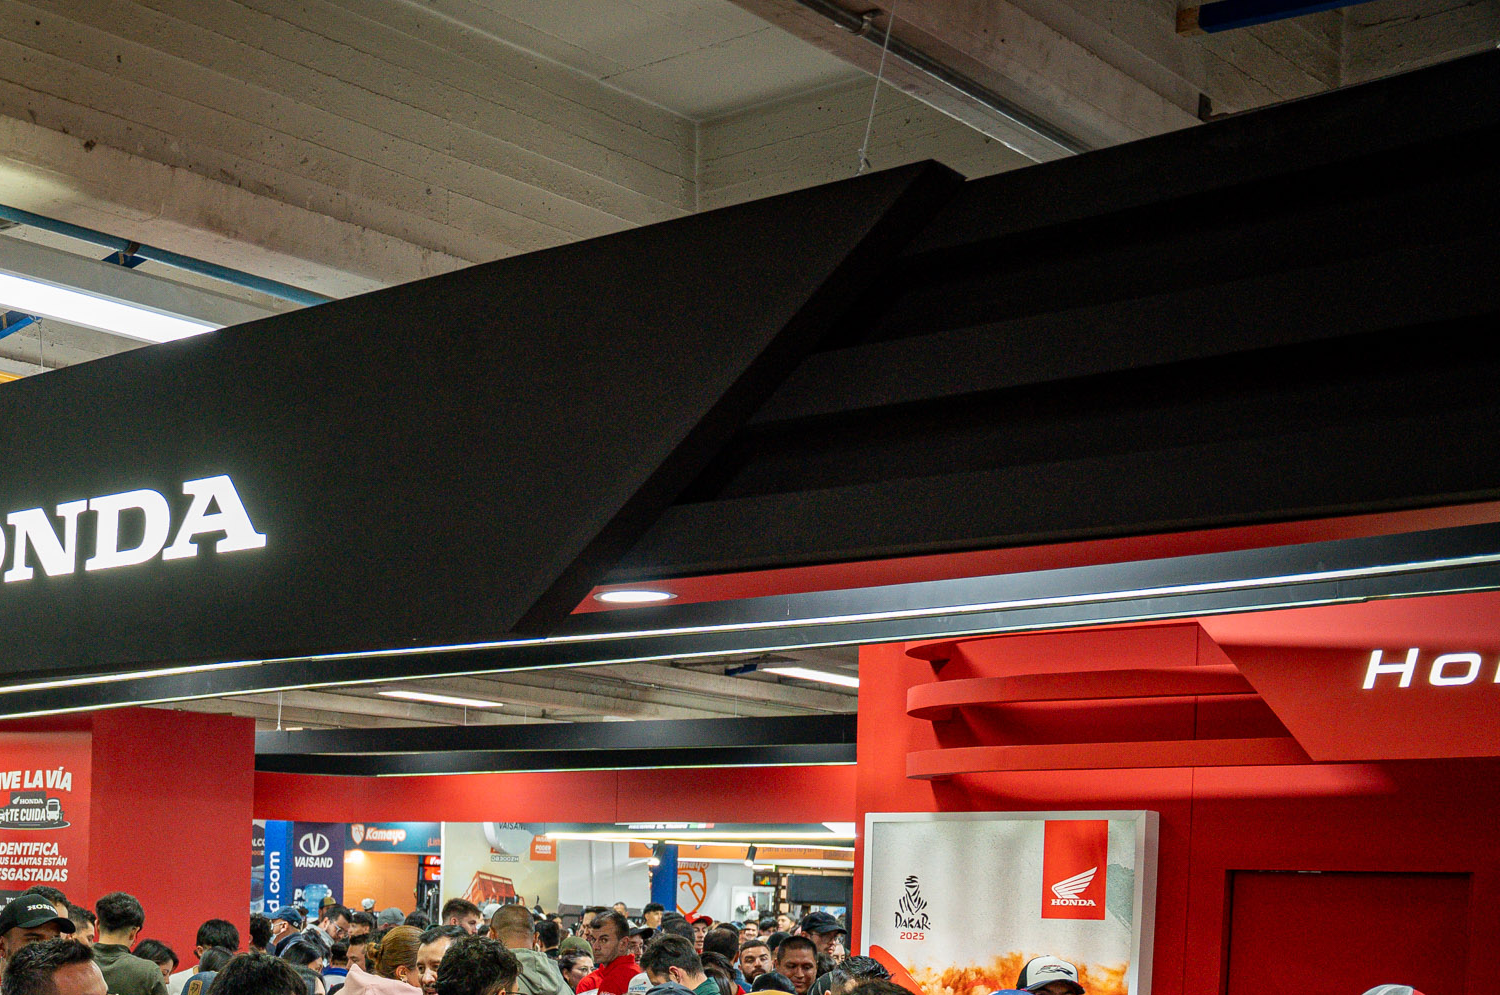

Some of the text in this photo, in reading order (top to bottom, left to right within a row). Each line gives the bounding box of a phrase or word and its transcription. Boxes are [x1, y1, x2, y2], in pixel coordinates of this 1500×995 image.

[1362, 647, 1500, 690] HO
[23, 769, 44, 789] LA
[46, 766, 72, 792] VÍA
[19, 797, 44, 805] HONDA
[9, 808, 46, 822] TE CUIDA
[365, 828, 407, 845] Kamayo
[10, 857, 42, 866] LLANTAS
[43, 855, 68, 867] ESTÁN
[294, 856, 333, 868] VAISAND
[1050, 898, 1097, 907] HONDA
[894, 912, 931, 931] DAKAR
[899, 931, 925, 941] 2025
